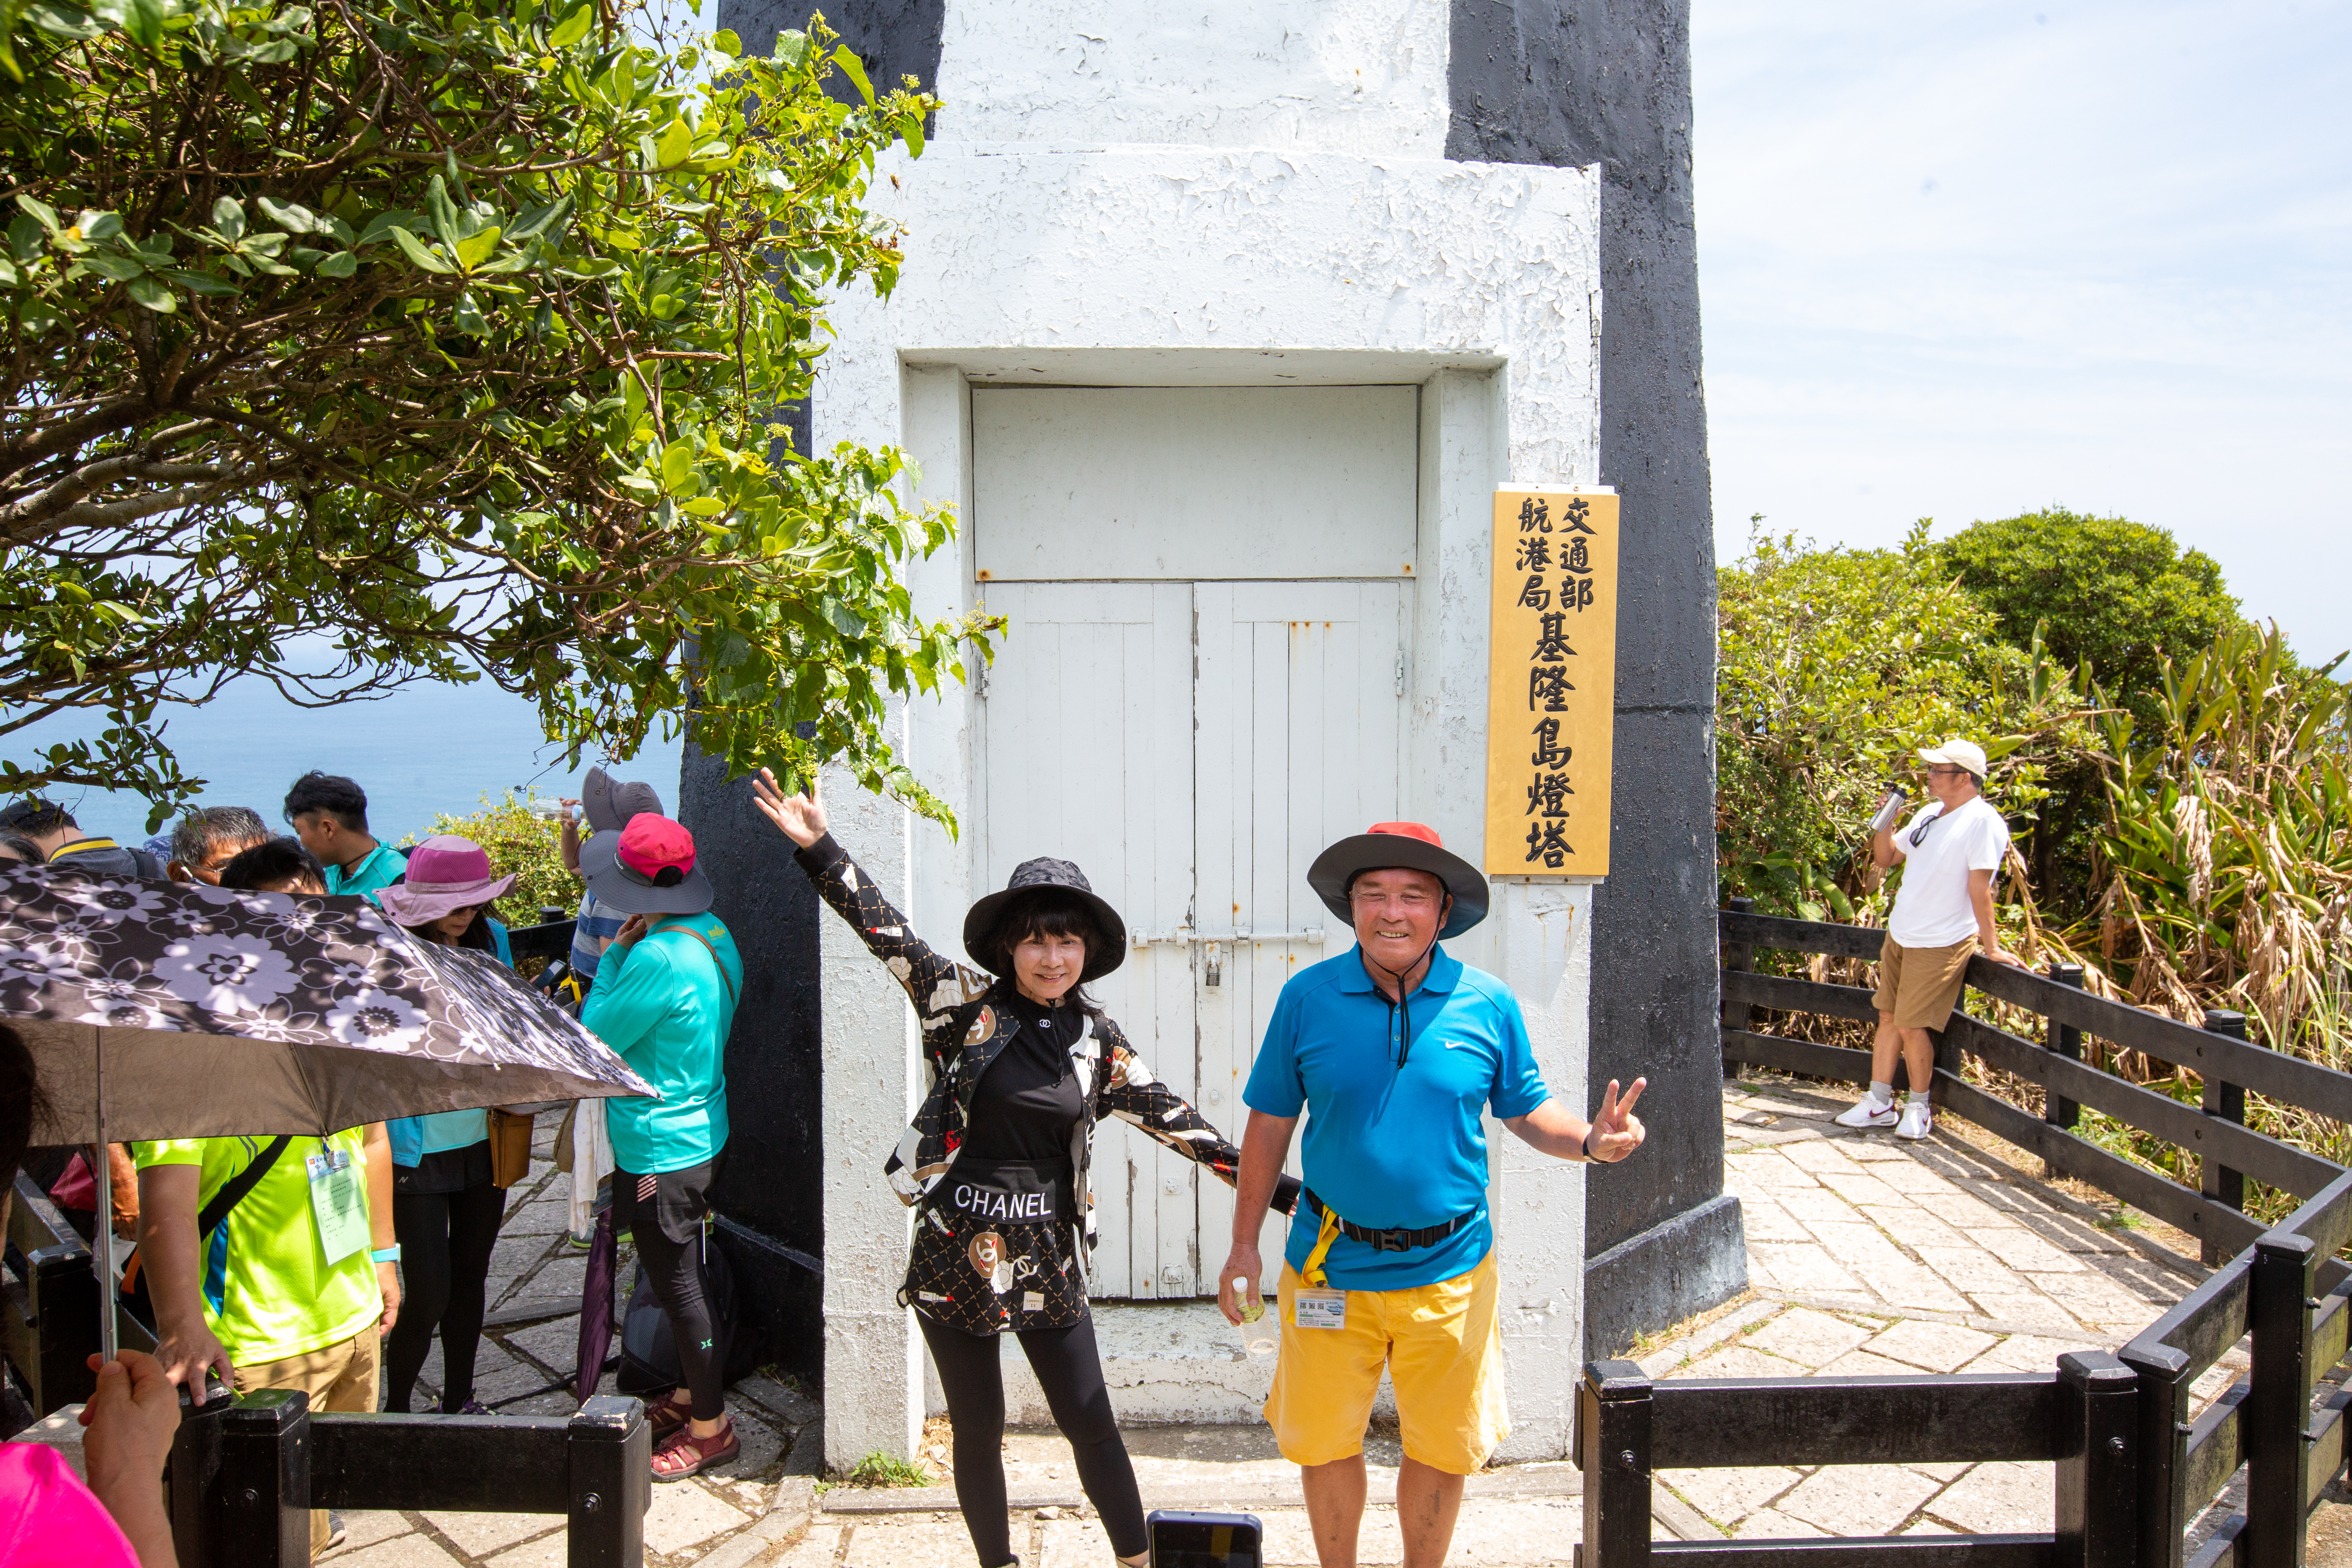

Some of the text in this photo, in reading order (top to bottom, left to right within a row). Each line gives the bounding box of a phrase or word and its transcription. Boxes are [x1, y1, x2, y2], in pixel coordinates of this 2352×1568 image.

[1516, 498, 1553, 612] 航港局
[1559, 498, 1598, 613] 交通部
[1525, 611, 1578, 869] 基隆島燈塔
[955, 1185, 1051, 1220] CHANEL
